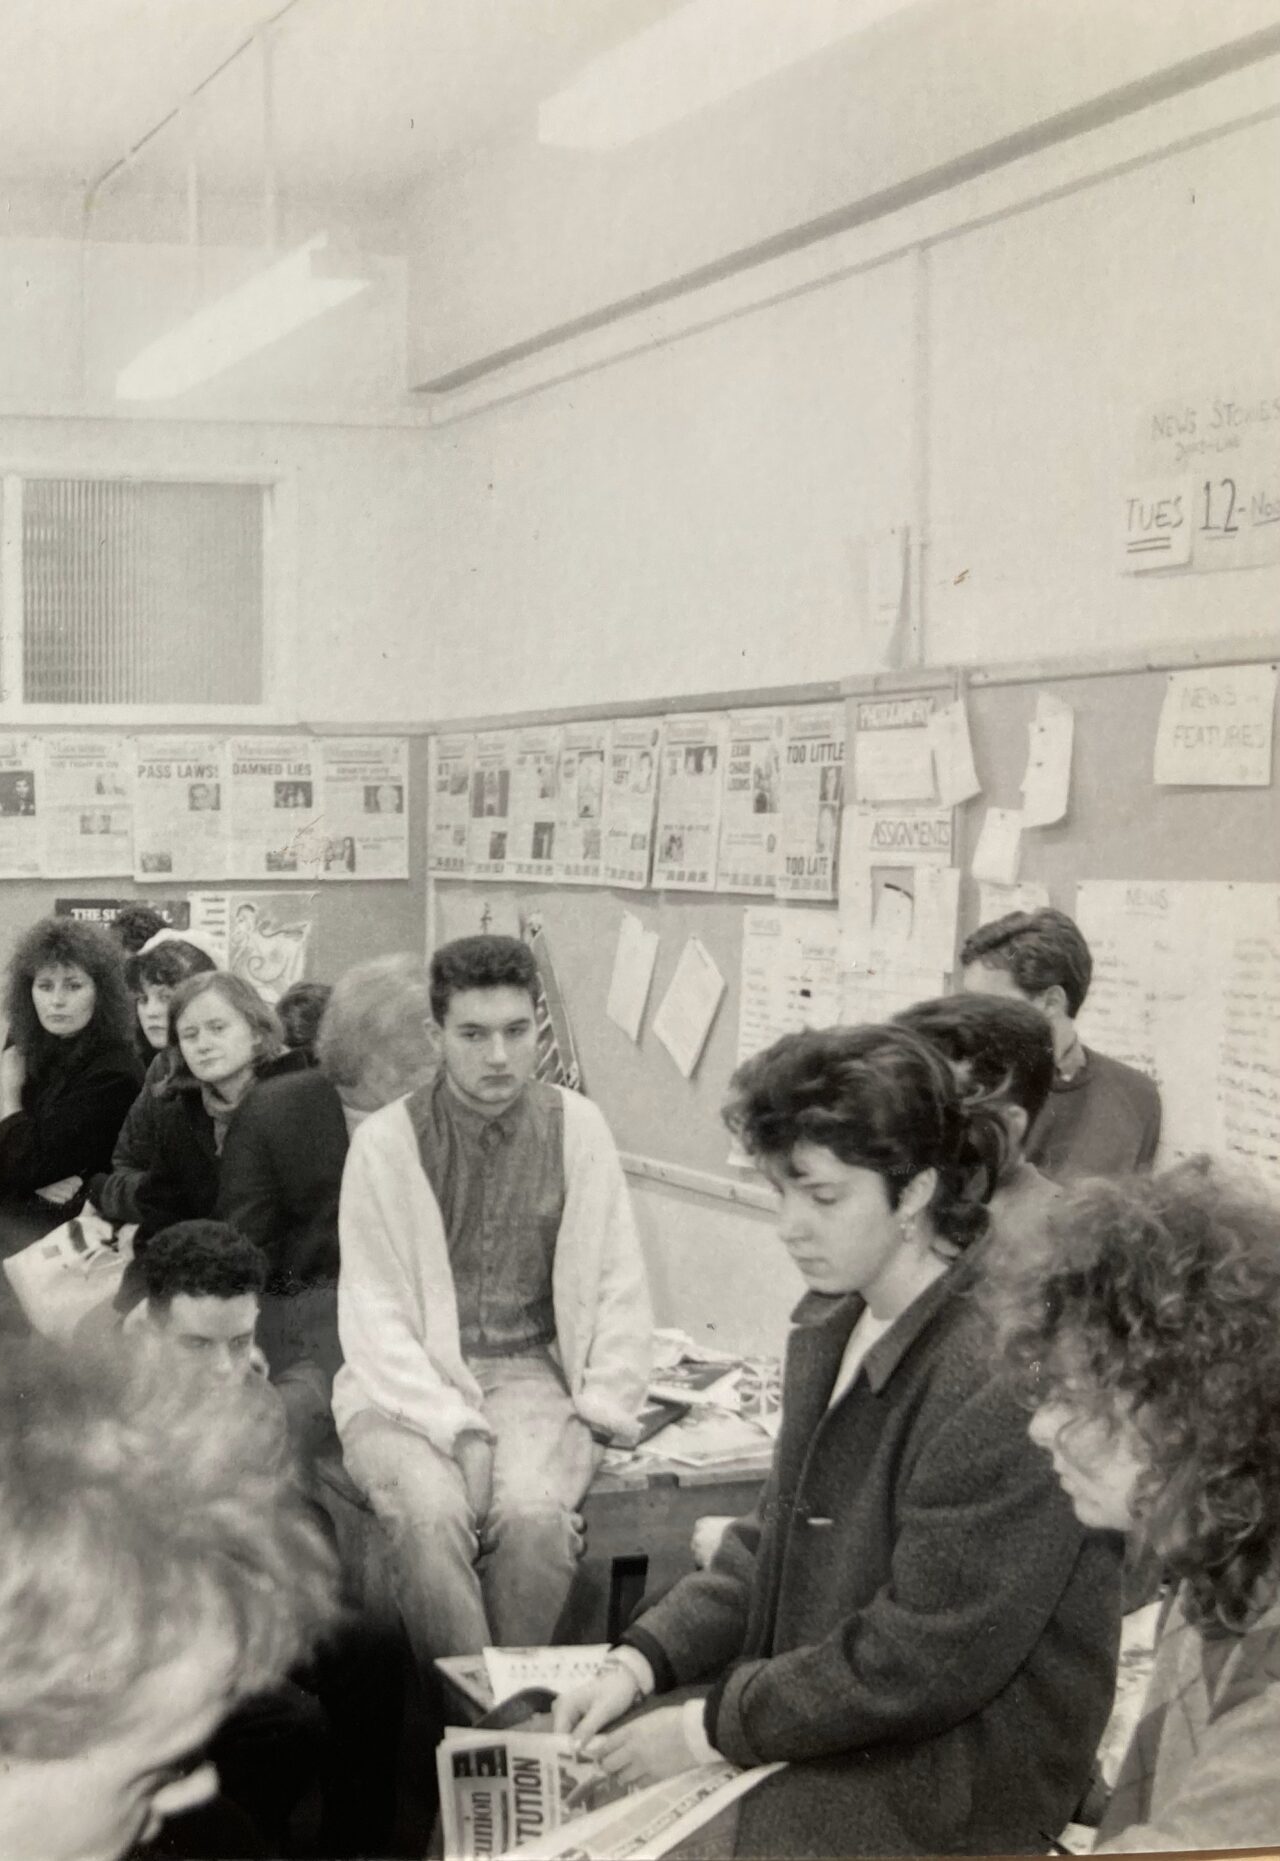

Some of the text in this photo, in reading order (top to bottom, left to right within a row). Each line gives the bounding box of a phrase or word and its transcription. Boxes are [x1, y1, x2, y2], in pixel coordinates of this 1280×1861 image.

[1125, 495, 1185, 532] TUES
[1172, 724, 1265, 750] FEATURES
[787, 741, 845, 764] TOO LITTLE
[137, 764, 171, 779] PASS
[232, 763, 312, 776] DAMNED LIES
[785, 856, 829, 876] TOO LATE
[512, 1756, 544, 1846] TUTION
